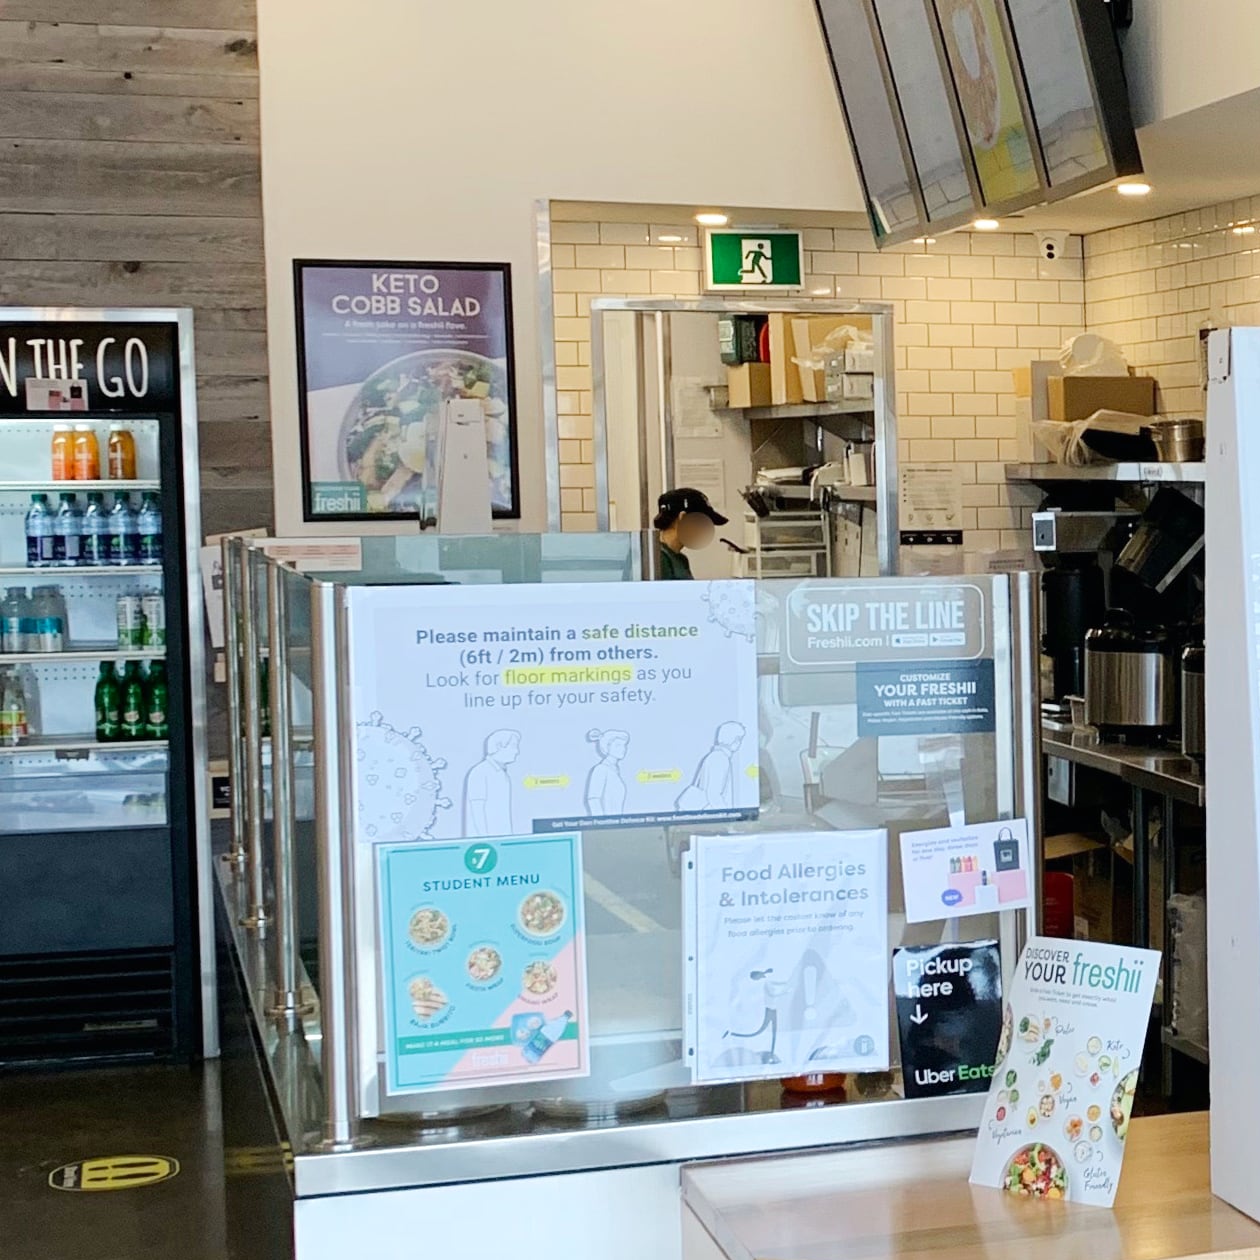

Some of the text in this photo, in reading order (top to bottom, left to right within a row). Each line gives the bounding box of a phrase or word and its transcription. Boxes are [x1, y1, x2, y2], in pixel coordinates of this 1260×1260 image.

[371, 273, 440, 294] KETO
[332, 295, 481, 317] COBB SALAD
[26, 339, 84, 379] THE
[96, 337, 149, 398] GO
[314, 492, 361, 511] freshii
[807, 600, 965, 633] SKIP THE LINE
[416, 623, 698, 645] Please maintain a safe distance
[807, 635, 883, 650] Freshii.com
[460, 645, 658, 667] (6ft / 2m) from others.
[426, 667, 692, 688] Look for floor markings as you
[900, 673, 951, 682] CUSTOMIZE
[464, 687, 656, 710] line up for your safety.
[874, 681, 976, 697] YOUR FRESHII
[884, 697, 968, 708] WITH A FAST TICKET
[721, 861, 866, 882] Food Allergies
[423, 873, 540, 892] STUDENT MENU
[719, 886, 869, 907] & Intolerances
[1026, 947, 1070, 963] DISCOVER
[906, 957, 973, 977] Pickup
[1024, 952, 1144, 993] YOUR freshii
[908, 980, 953, 998] here
[914, 1064, 995, 1085] Uber Eats
